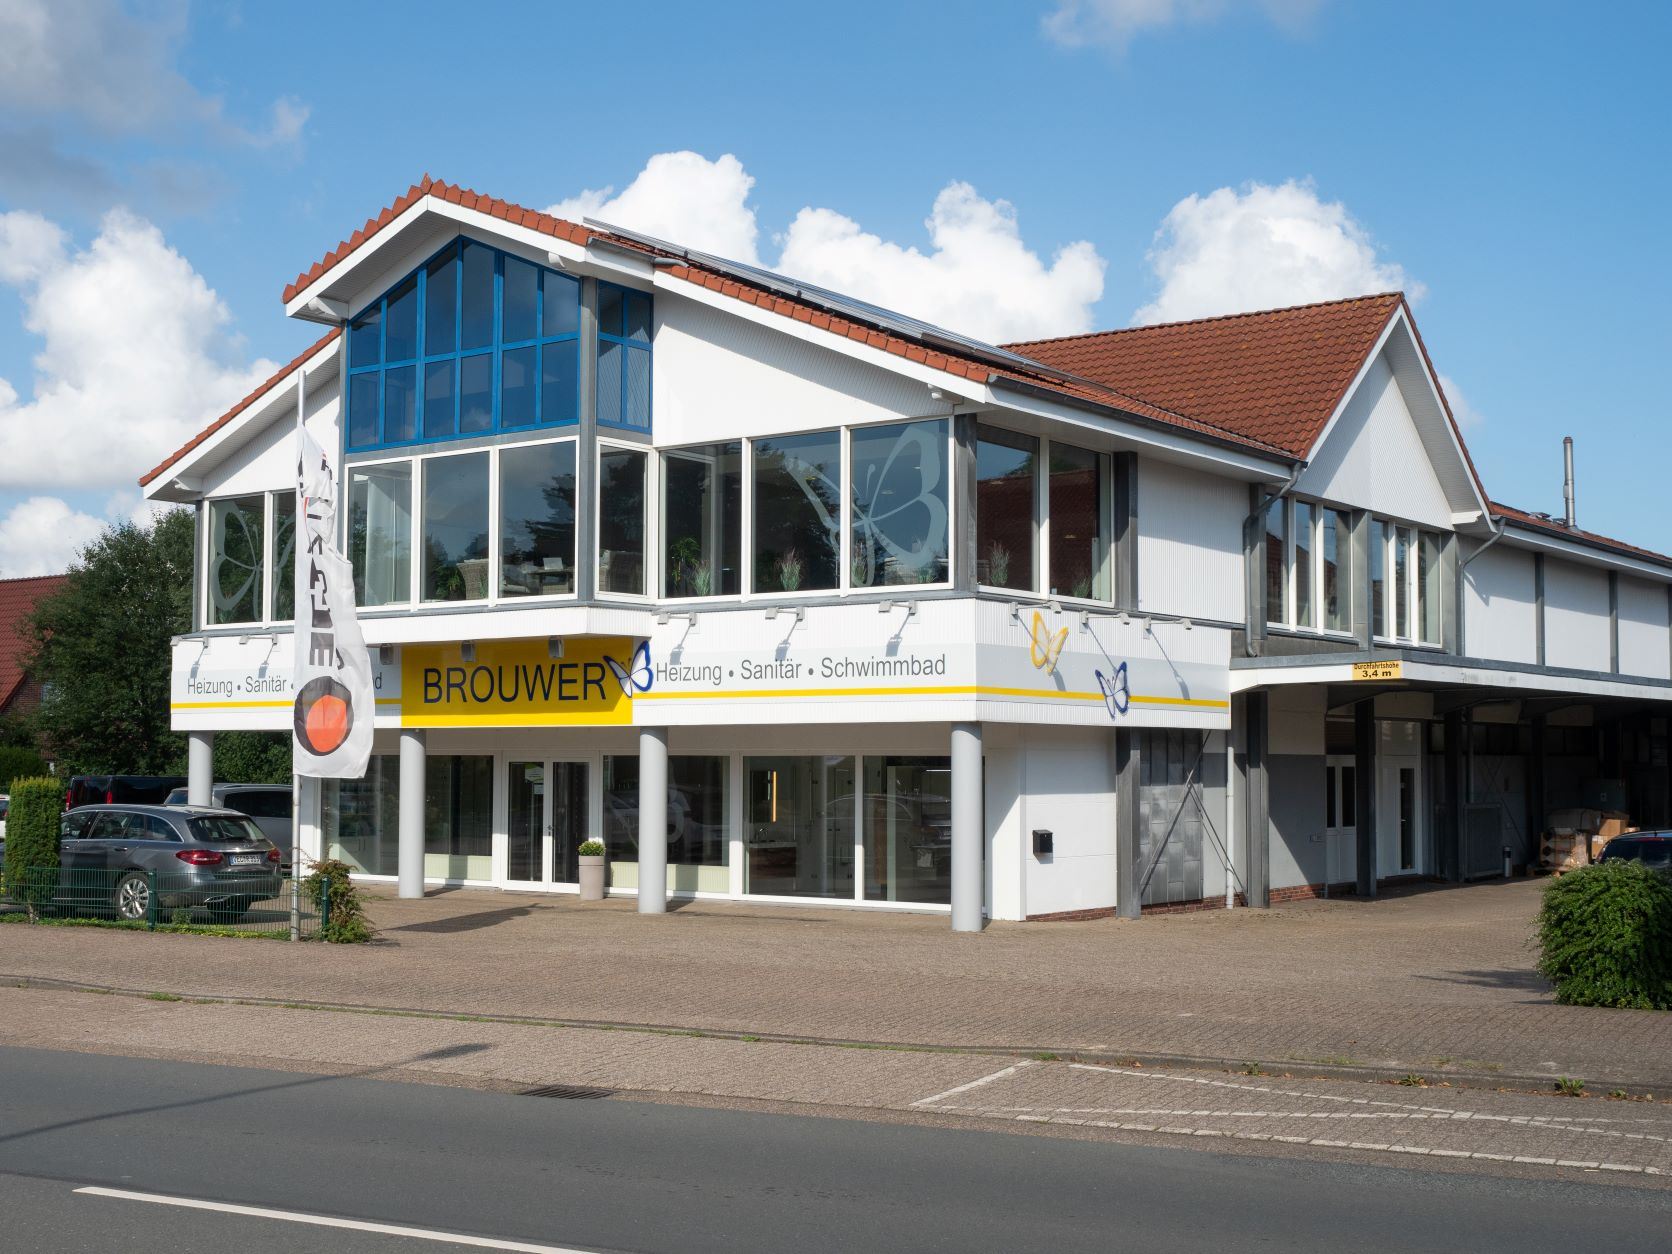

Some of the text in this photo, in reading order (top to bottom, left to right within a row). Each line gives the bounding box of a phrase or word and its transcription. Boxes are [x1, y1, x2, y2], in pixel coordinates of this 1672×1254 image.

[423, 663, 607, 704] BROUWER
[655, 653, 946, 687] Heizung Sanitär Schwimmbad
[1362, 670, 1378, 678] 3,4
[187, 675, 287, 698] Heizung Sanitär
